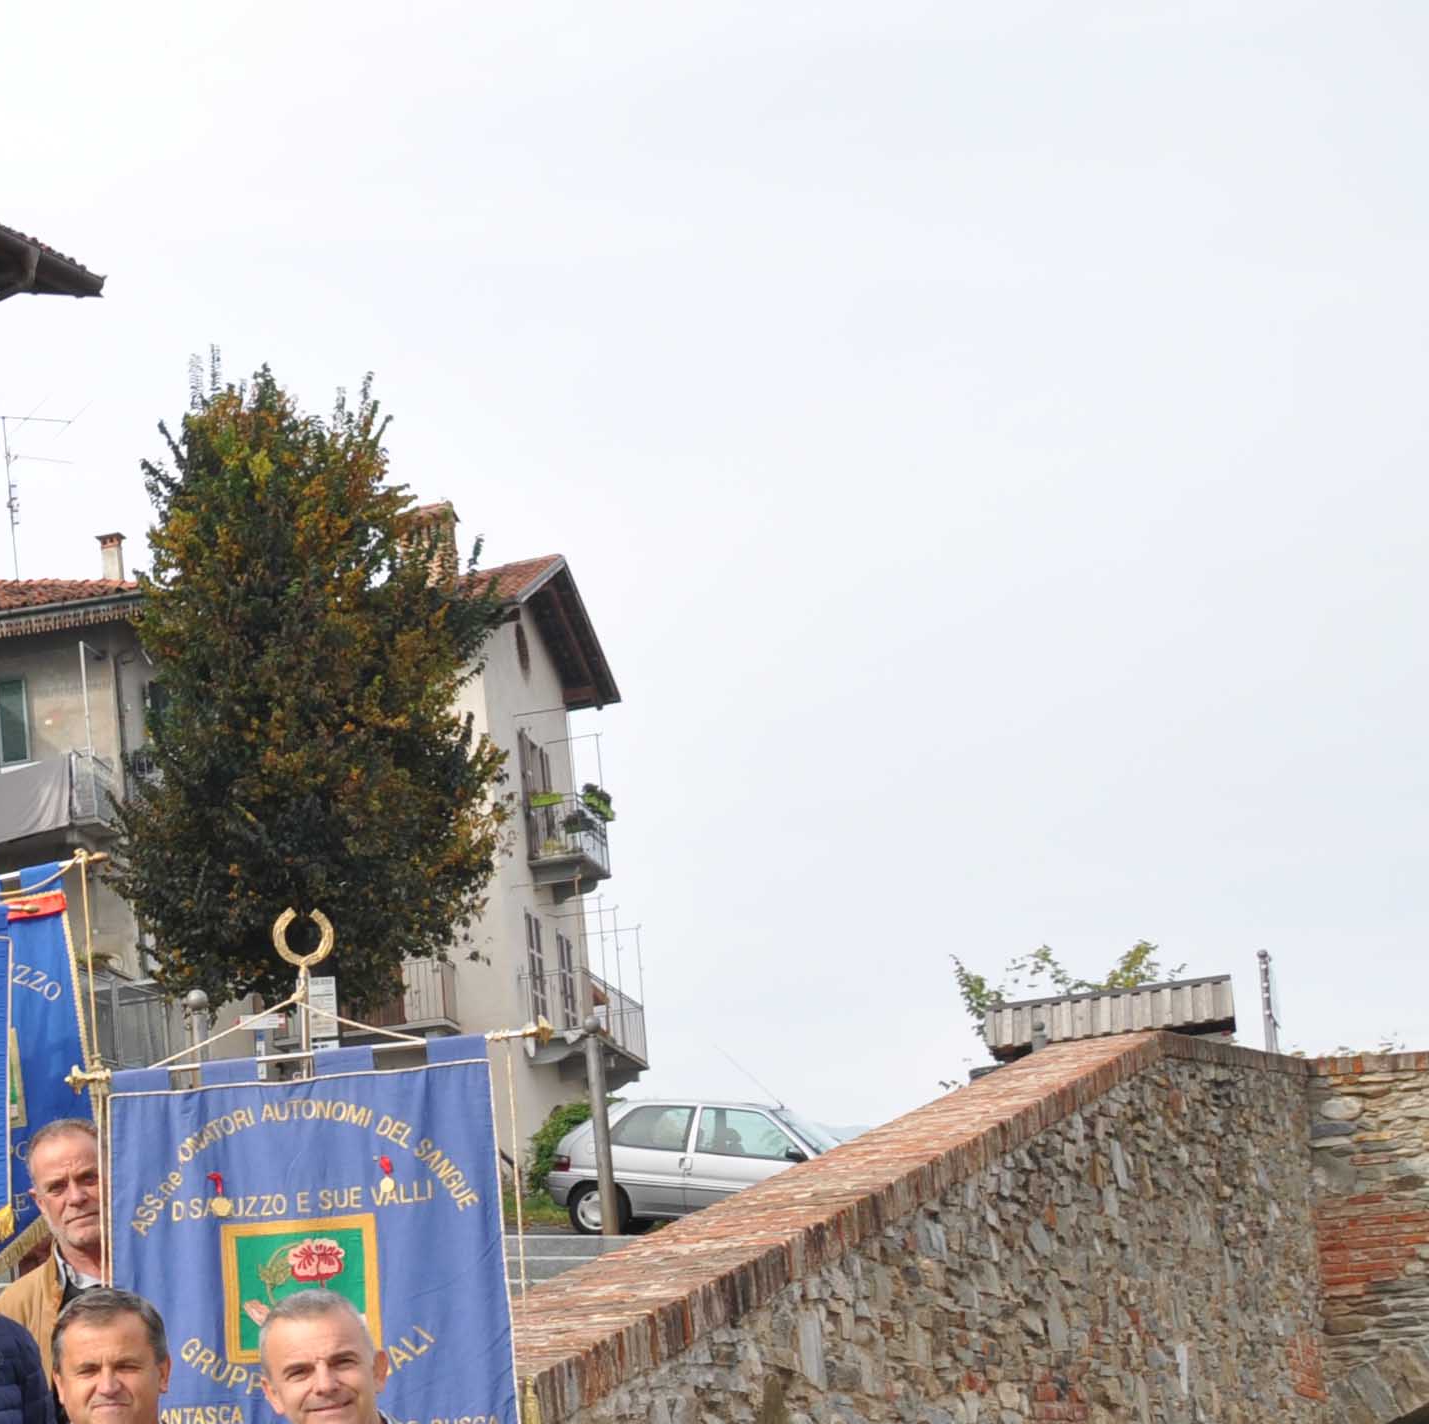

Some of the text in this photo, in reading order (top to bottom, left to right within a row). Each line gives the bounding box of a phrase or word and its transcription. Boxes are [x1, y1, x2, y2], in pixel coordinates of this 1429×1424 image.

[261, 1100, 374, 1129] AUTONOMI
[376, 1114, 411, 1150] DEL
[414, 1138, 480, 1212] SANGUE
[297, 1191, 312, 1213] E
[319, 1188, 363, 1211] SUE
